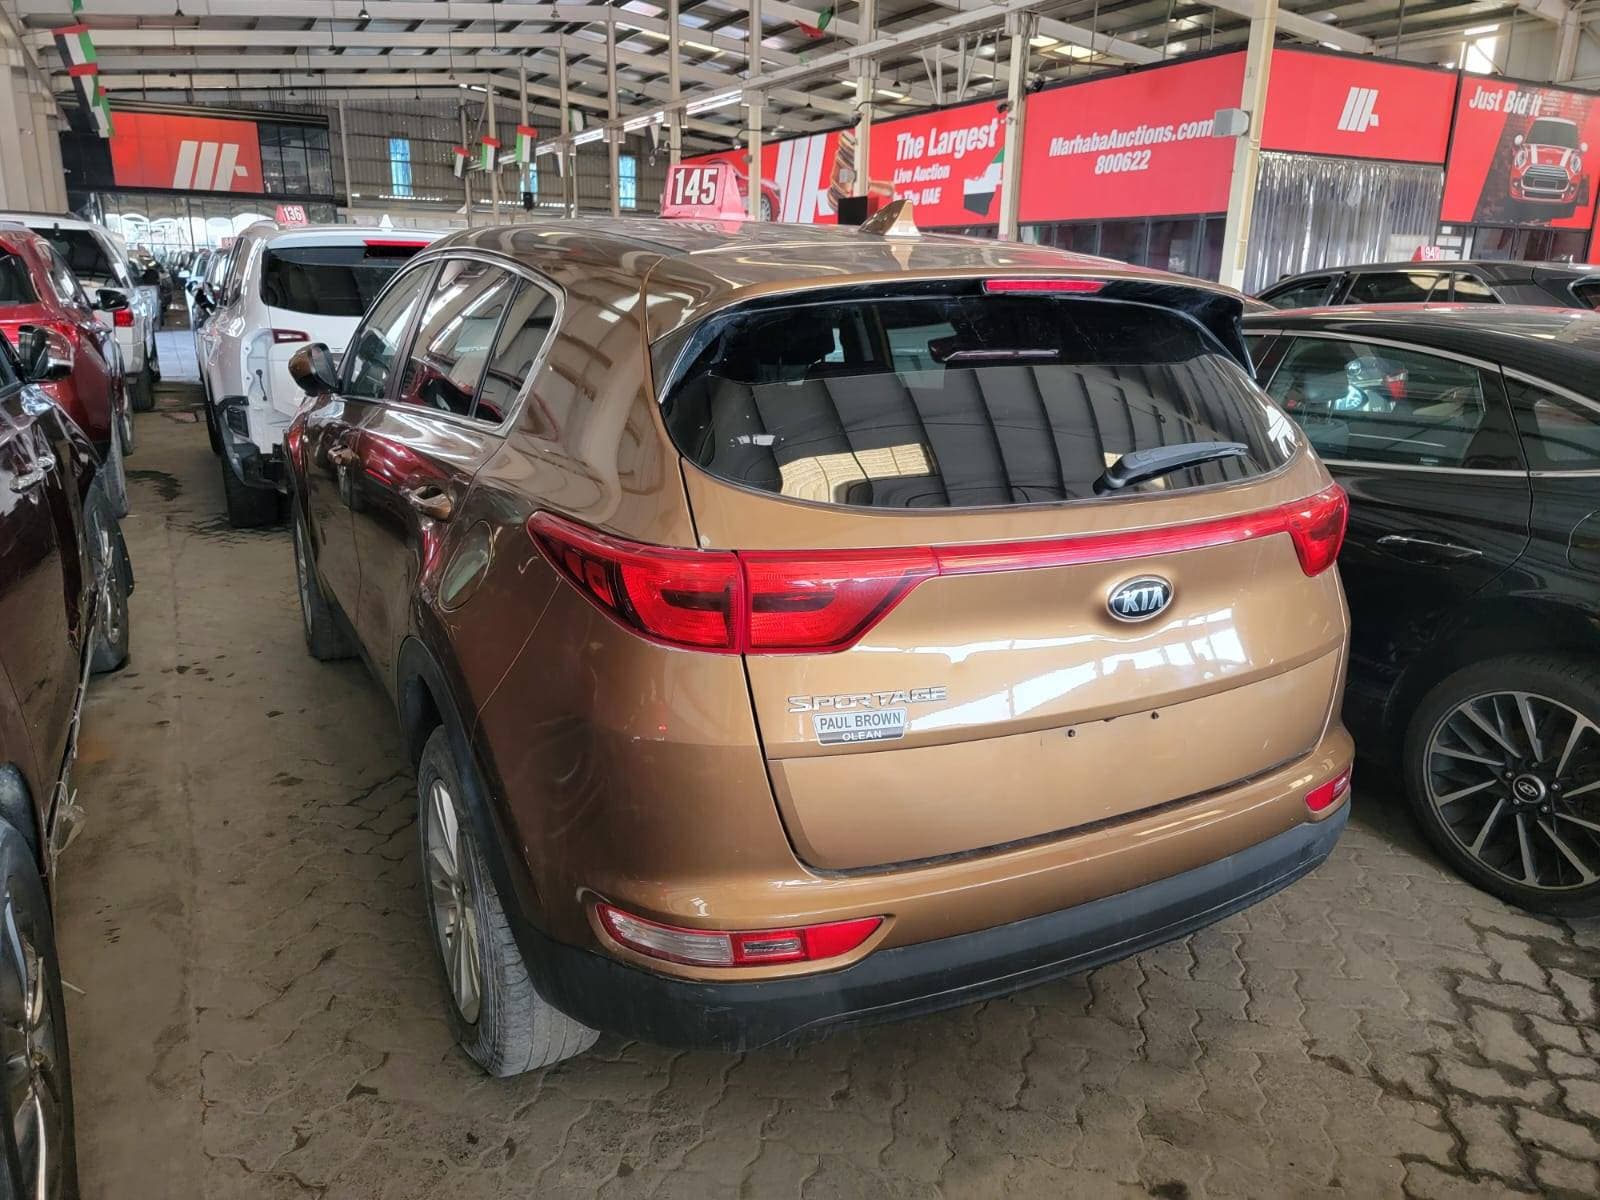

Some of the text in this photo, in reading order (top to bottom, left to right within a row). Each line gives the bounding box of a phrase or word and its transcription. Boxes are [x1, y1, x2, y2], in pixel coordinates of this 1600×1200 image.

[1469, 85, 1543, 117] Just Bid It
[896, 118, 998, 161] The Largest
[1049, 119, 1214, 157] MarhabaAuctions.com
[894, 163, 951, 185] Live Auction
[1094, 149, 1151, 175] 800622
[675, 168, 718, 205] 145
[921, 187, 942, 206] UAE
[284, 206, 303, 221] 136
[1122, 586, 1164, 613] KIA
[788, 686, 948, 713] SPORTAGE
[820, 711, 901, 730] PAUL BROWN
[842, 730, 882, 742] OLEAN
